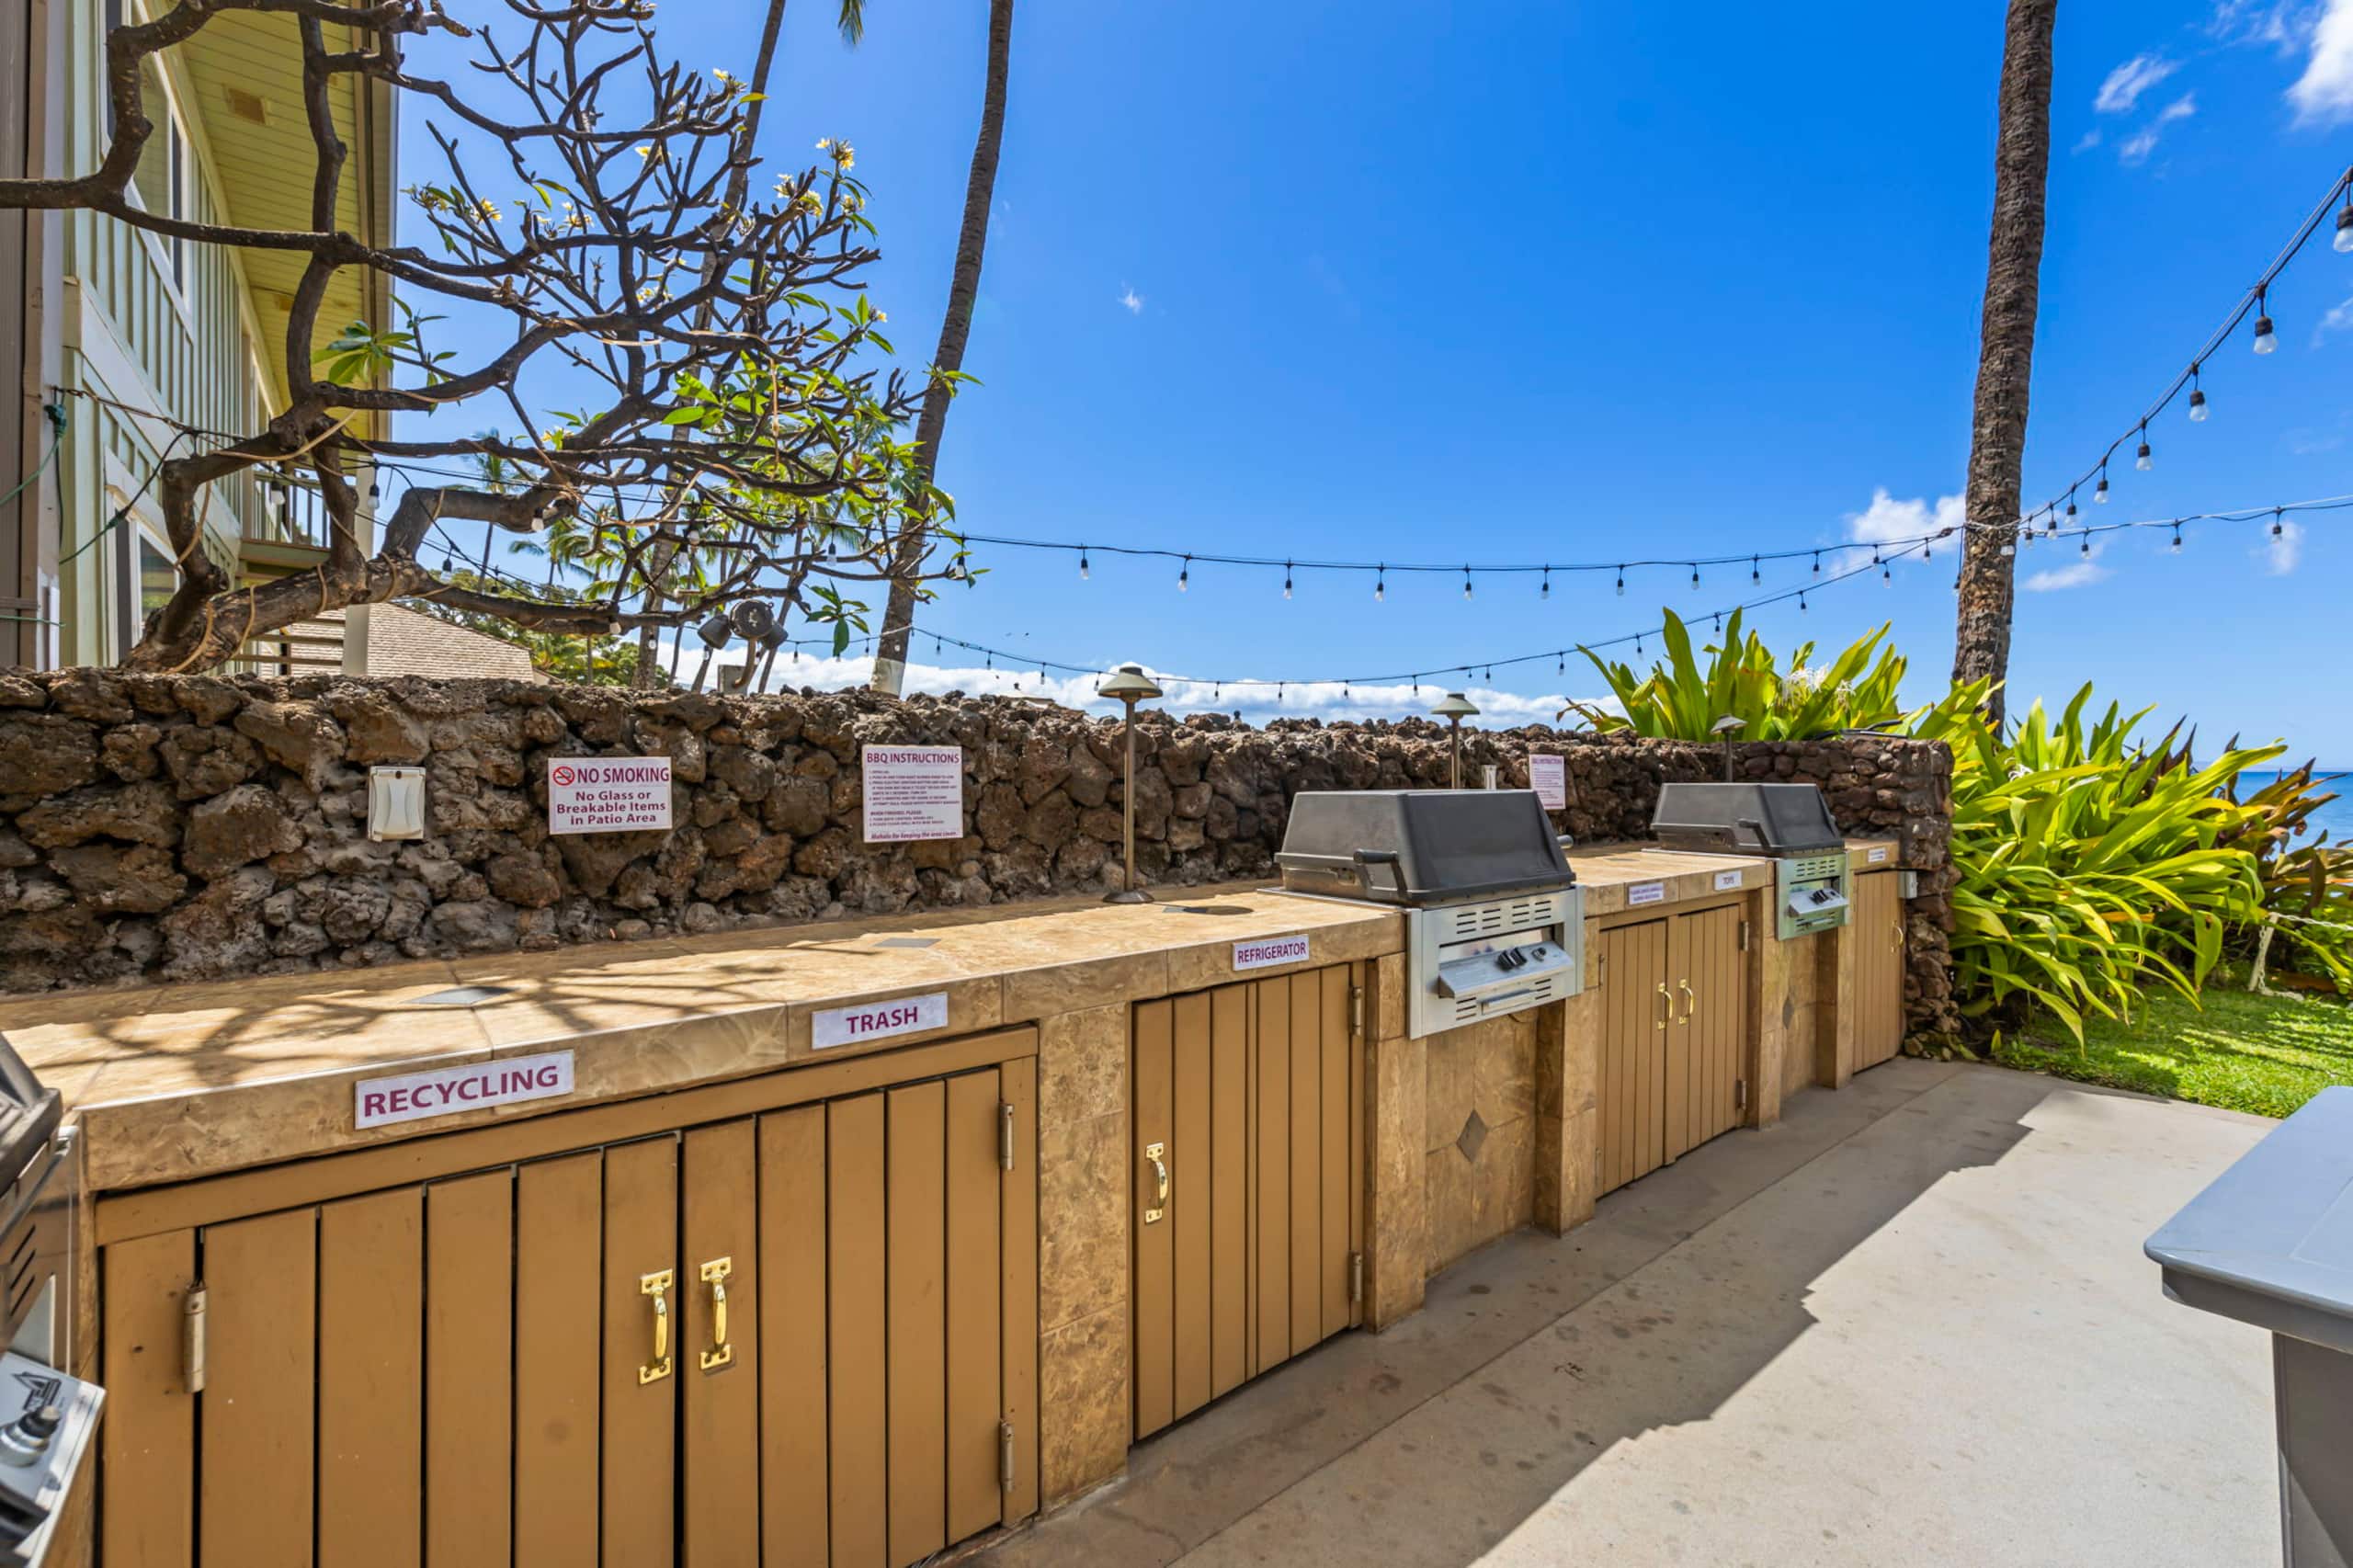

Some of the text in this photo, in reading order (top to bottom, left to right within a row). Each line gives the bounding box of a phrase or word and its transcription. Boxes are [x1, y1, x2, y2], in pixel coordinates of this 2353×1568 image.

[867, 753, 960, 764] BBQ INSTRUCTIONS
[577, 767, 670, 783] NO SMOKING
[575, 790, 652, 801] No Glass or
[557, 801, 665, 814] Breakable Items
[570, 812, 656, 825] in Patio Area
[1237, 942, 1306, 964] REFRIGERATOR
[846, 1006, 918, 1034] TRASH
[364, 1065, 559, 1118] RECYCLING
